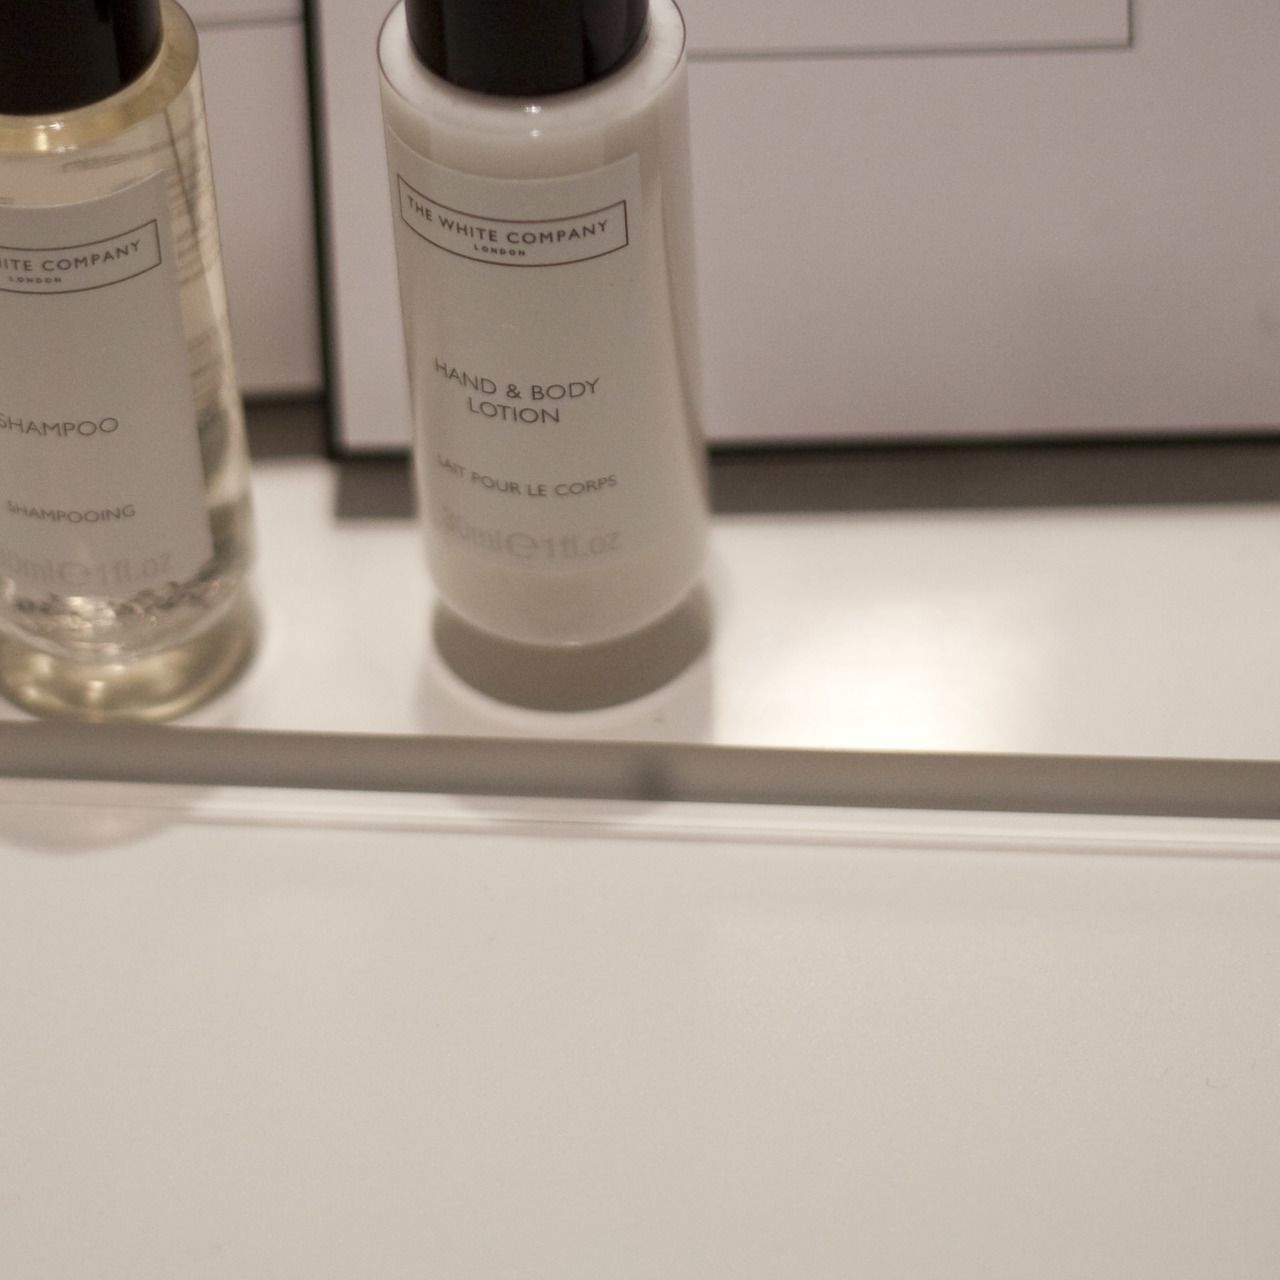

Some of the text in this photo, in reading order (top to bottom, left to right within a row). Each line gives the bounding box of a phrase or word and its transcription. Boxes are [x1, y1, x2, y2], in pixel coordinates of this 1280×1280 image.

[406, 195, 609, 246] THE WHITE COMPANY
[41, 238, 141, 272] COMPANY
[474, 244, 527, 257] LONDON
[8, 275, 62, 285] LONDON
[434, 357, 601, 402] HAND & BODY
[468, 396, 561, 425] LOTION
[471, 471, 521, 497] POUR
[527, 483, 548, 498] LE
[554, 473, 619, 497] CORPS
[5, 499, 137, 524] SHAMPOOING
